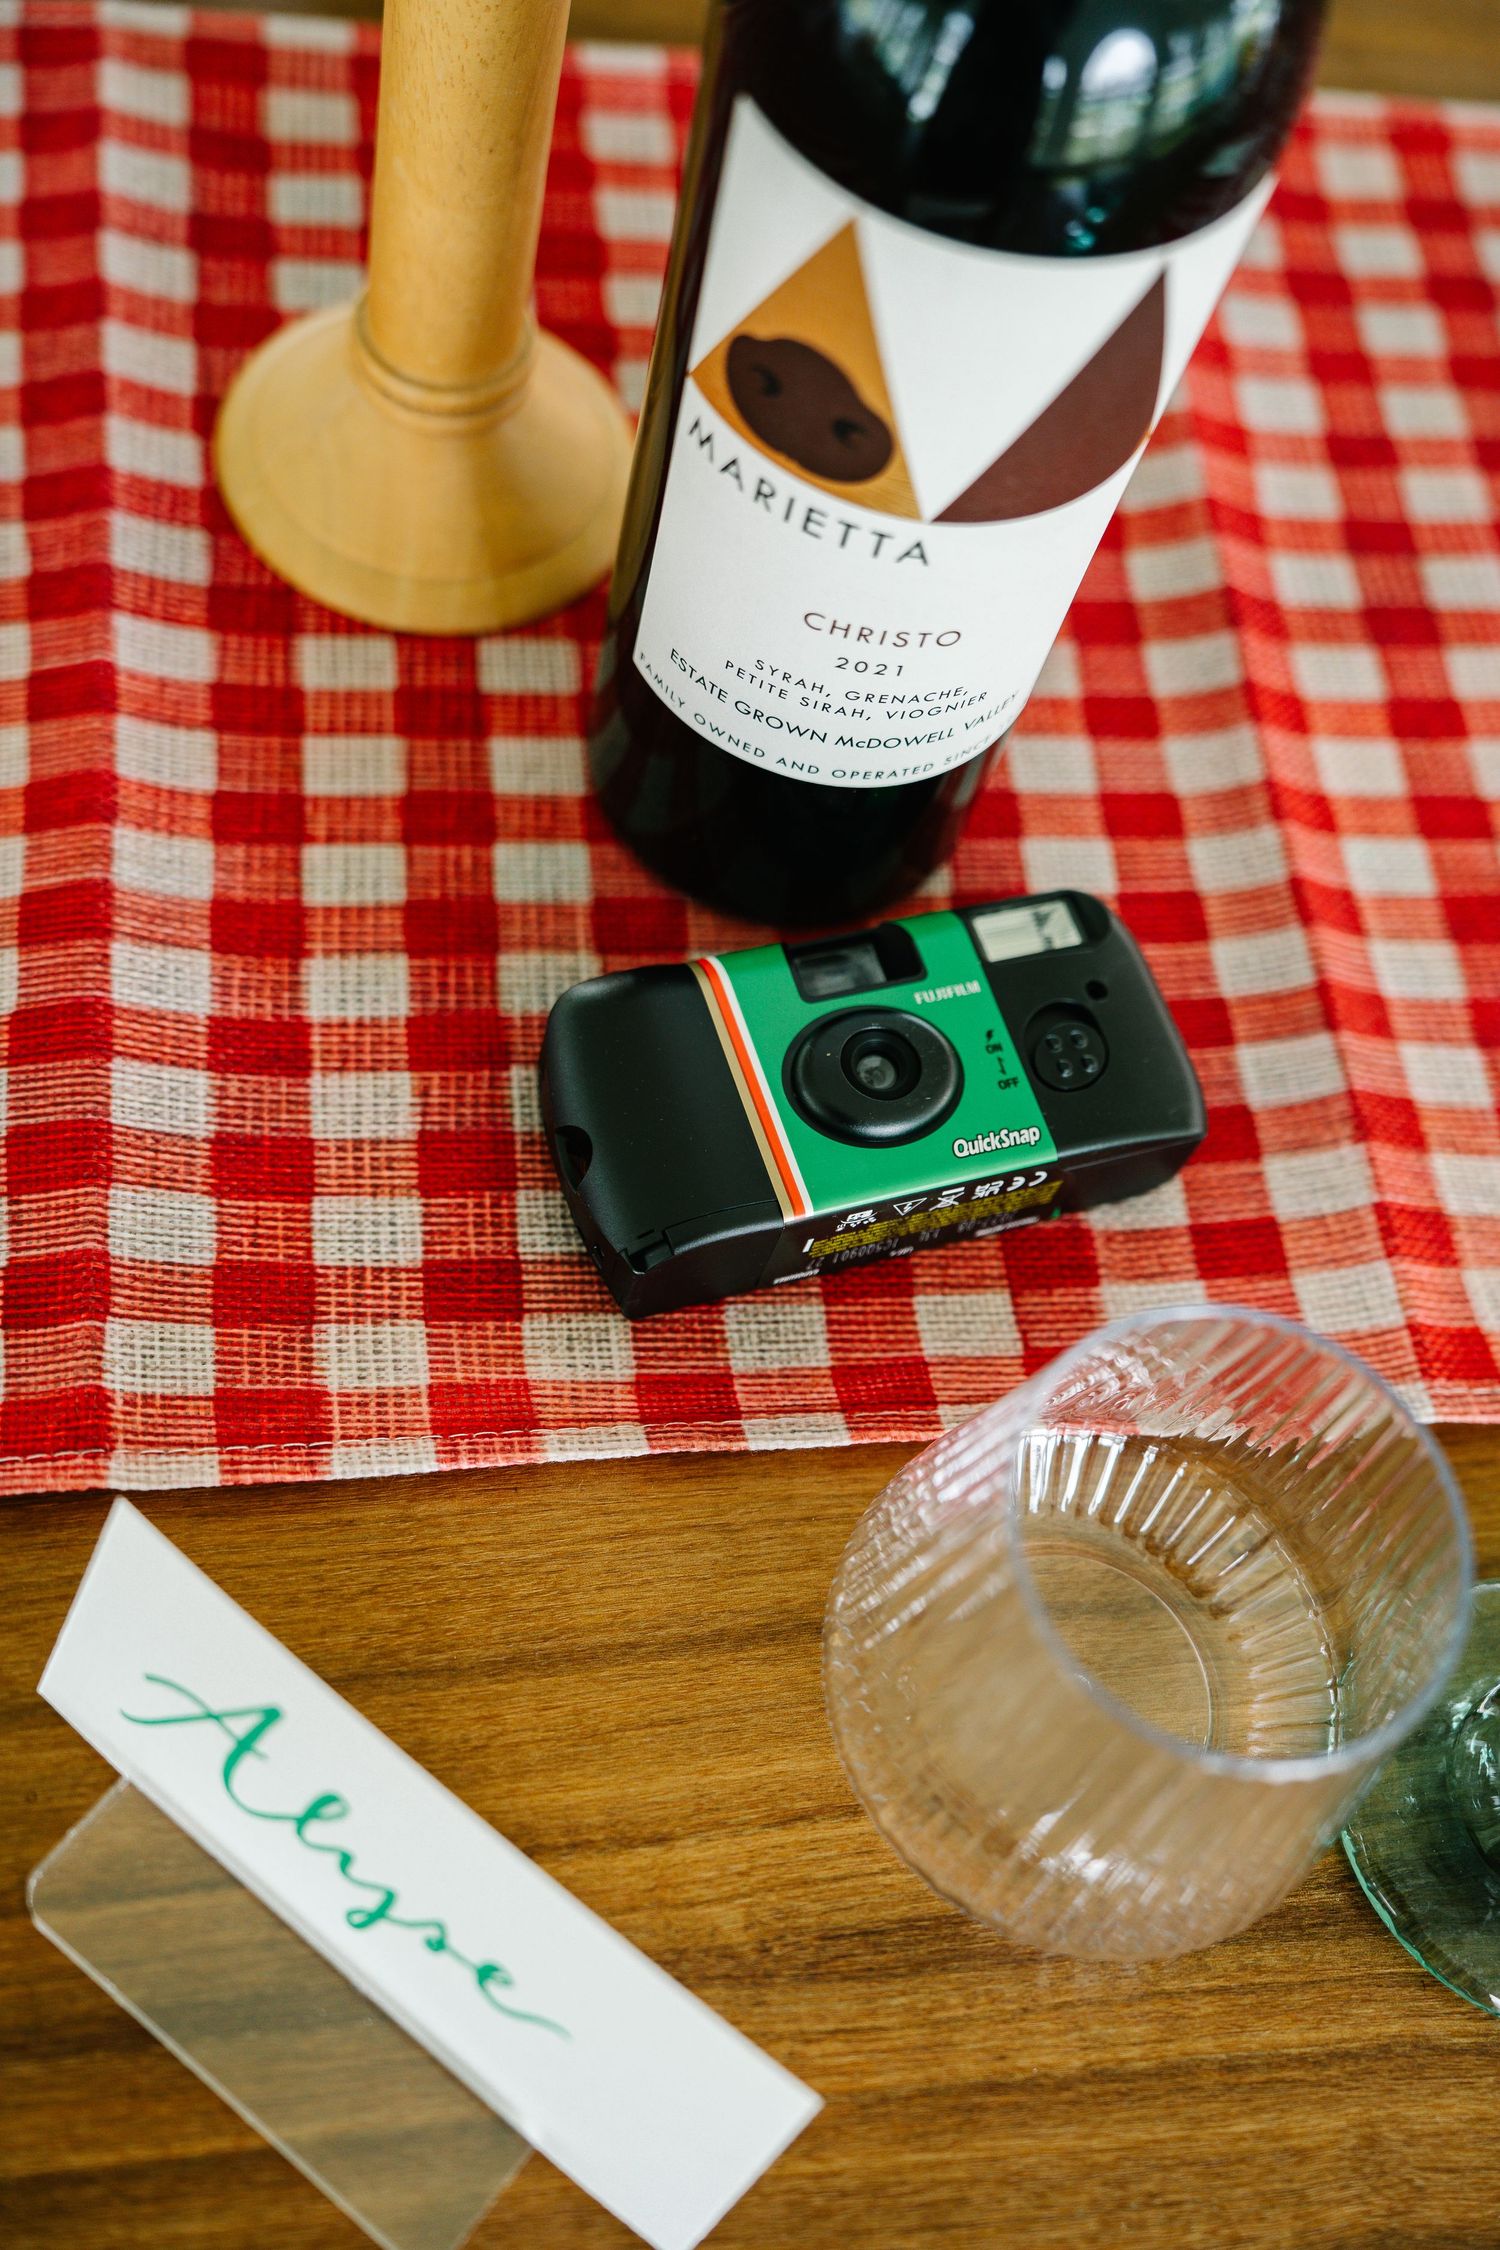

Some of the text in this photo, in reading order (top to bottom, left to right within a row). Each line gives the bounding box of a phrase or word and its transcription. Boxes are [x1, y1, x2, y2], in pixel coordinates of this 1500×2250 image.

[688, 417, 929, 567] MARIETTA
[803, 611, 962, 650] CHRISTO
[754, 659, 969, 706] SYRAH, GRENACHE,
[834, 656, 905, 678] 2021
[670, 648, 729, 704] ESTATE
[734, 700, 828, 745] GROWN
[834, 728, 955, 750] McDOWELL
[964, 689, 1020, 732] VALLEY
[725, 660, 988, 722] PETITE SIRAH, VIOGNIER
[639, 652, 686, 709] FAMILY
[694, 712, 767, 759] OWNED
[775, 757, 820, 776] AND
[831, 763, 935, 781] OPERATED
[913, 980, 982, 1005] FUJIFILM
[997, 1077, 1020, 1091] OFF
[953, 1126, 1041, 1158] QuickSnap
[120, 1672, 574, 2041] Alyse
